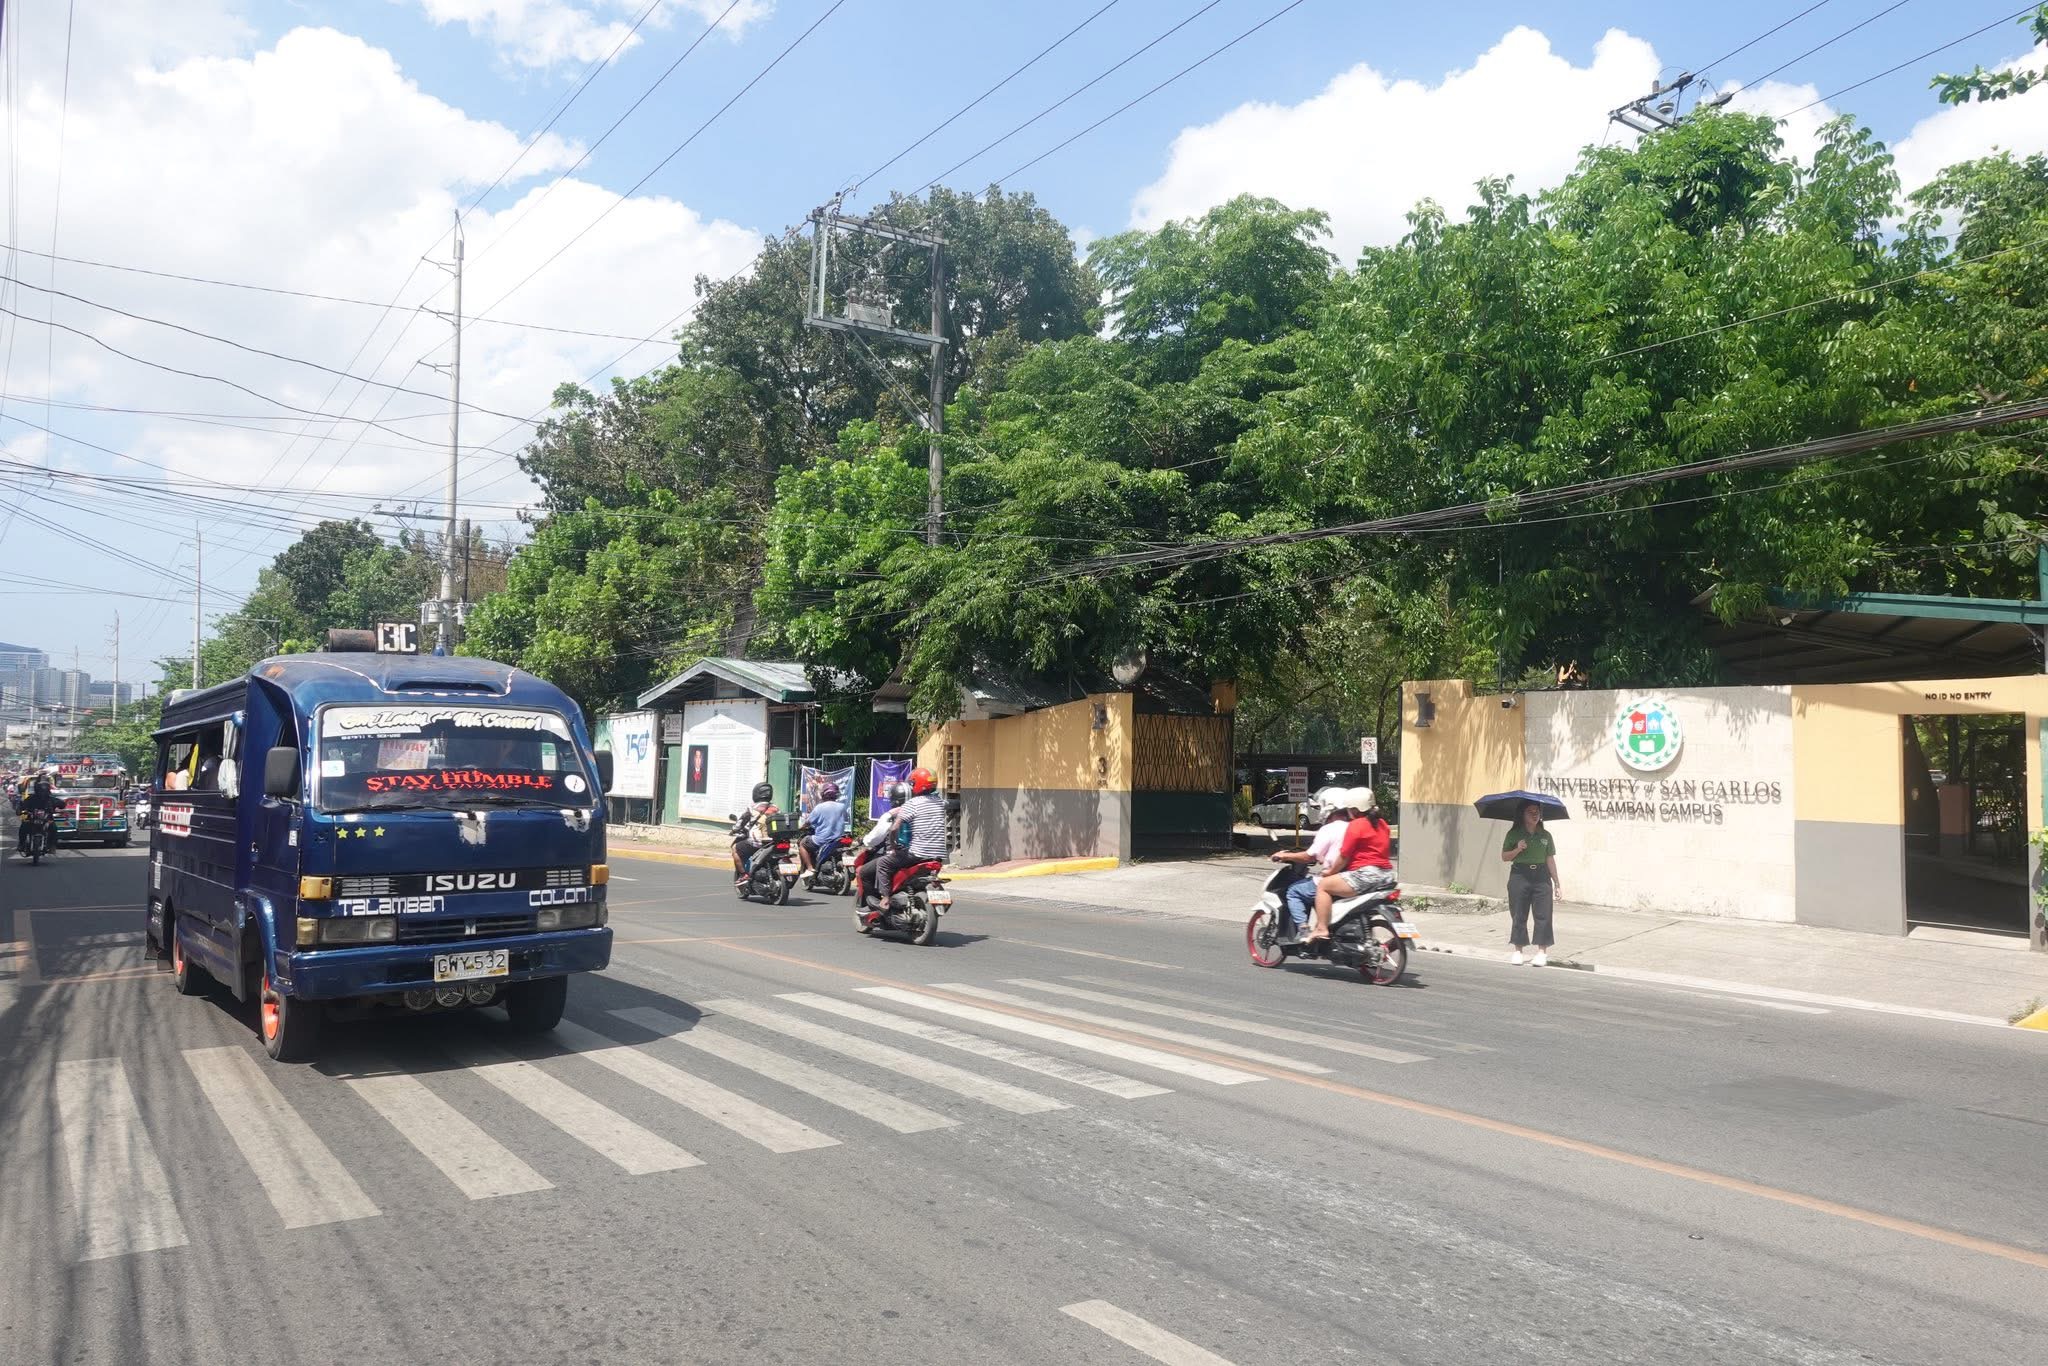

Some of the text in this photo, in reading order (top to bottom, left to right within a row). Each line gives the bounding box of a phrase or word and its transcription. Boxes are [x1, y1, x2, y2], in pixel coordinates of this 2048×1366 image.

[377, 623, 416, 652] 13C
[1964, 691, 1992, 700] ENTRY
[366, 774, 436, 791] STAY
[442, 771, 552, 788] HUMBLE
[1538, 777, 1782, 797] UNIVERSITY of SAN CARLOS
[1584, 800, 1723, 816] TALAMBAN CAMPUS
[426, 872, 516, 892] ISUZU
[438, 953, 505, 973] GWY 532
